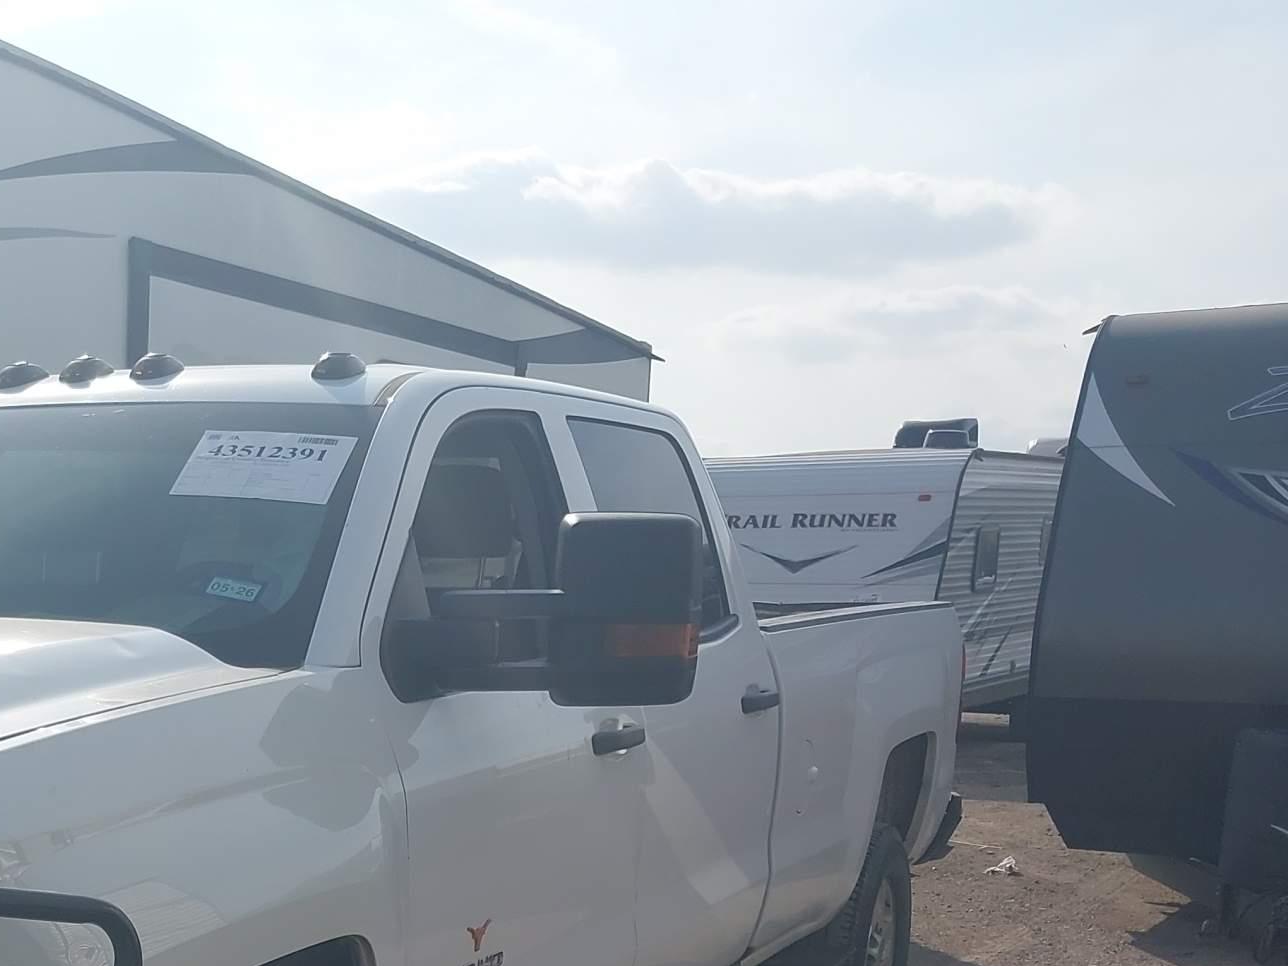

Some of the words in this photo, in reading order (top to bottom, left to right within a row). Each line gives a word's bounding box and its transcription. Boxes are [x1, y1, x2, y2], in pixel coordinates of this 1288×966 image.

[207, 444, 328, 462] 43512391
[724, 514, 782, 529] RAIL
[790, 512, 898, 528] RUNNER
